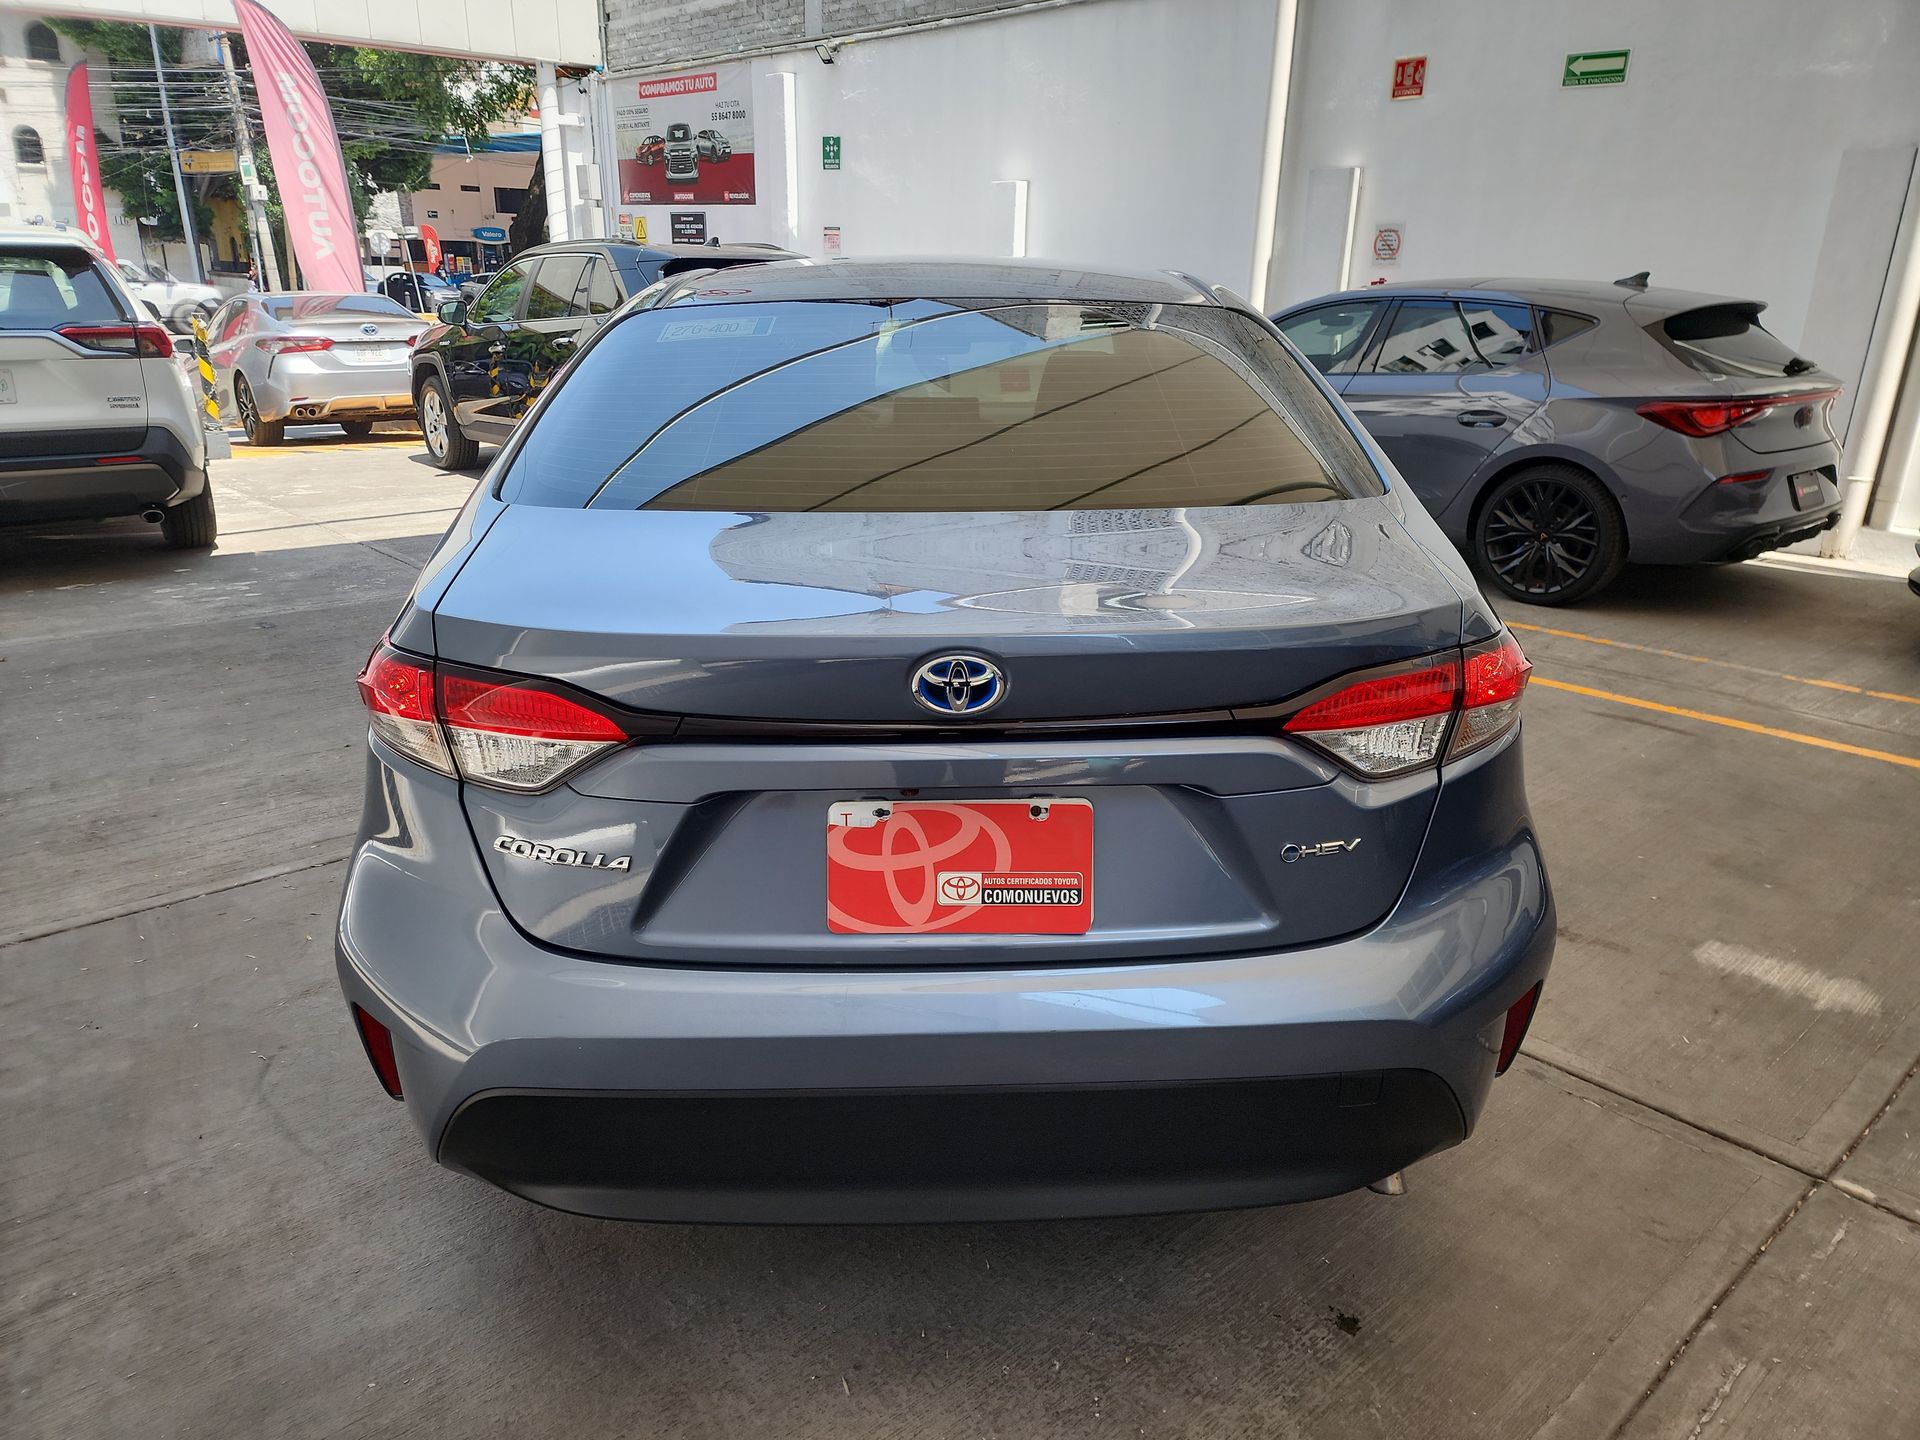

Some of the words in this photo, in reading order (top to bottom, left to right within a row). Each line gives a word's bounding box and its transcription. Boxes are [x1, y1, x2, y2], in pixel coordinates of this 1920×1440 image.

[641, 80, 685, 96] COMPRAMOS
[685, 79, 695, 91] TU
[695, 76, 714, 90] AUTO
[635, 107, 649, 115] SEGURO
[711, 112, 718, 121] 55
[718, 111, 731, 120] 8647
[732, 110, 746, 119] 8000
[493, 835, 632, 873] COROLLA
[983, 877, 1006, 885] AUTOS
[1006, 877, 1053, 885] CERTIFICADOS
[1054, 877, 1079, 885] TOYOTA
[984, 889, 1079, 904] COMONUEVOS
